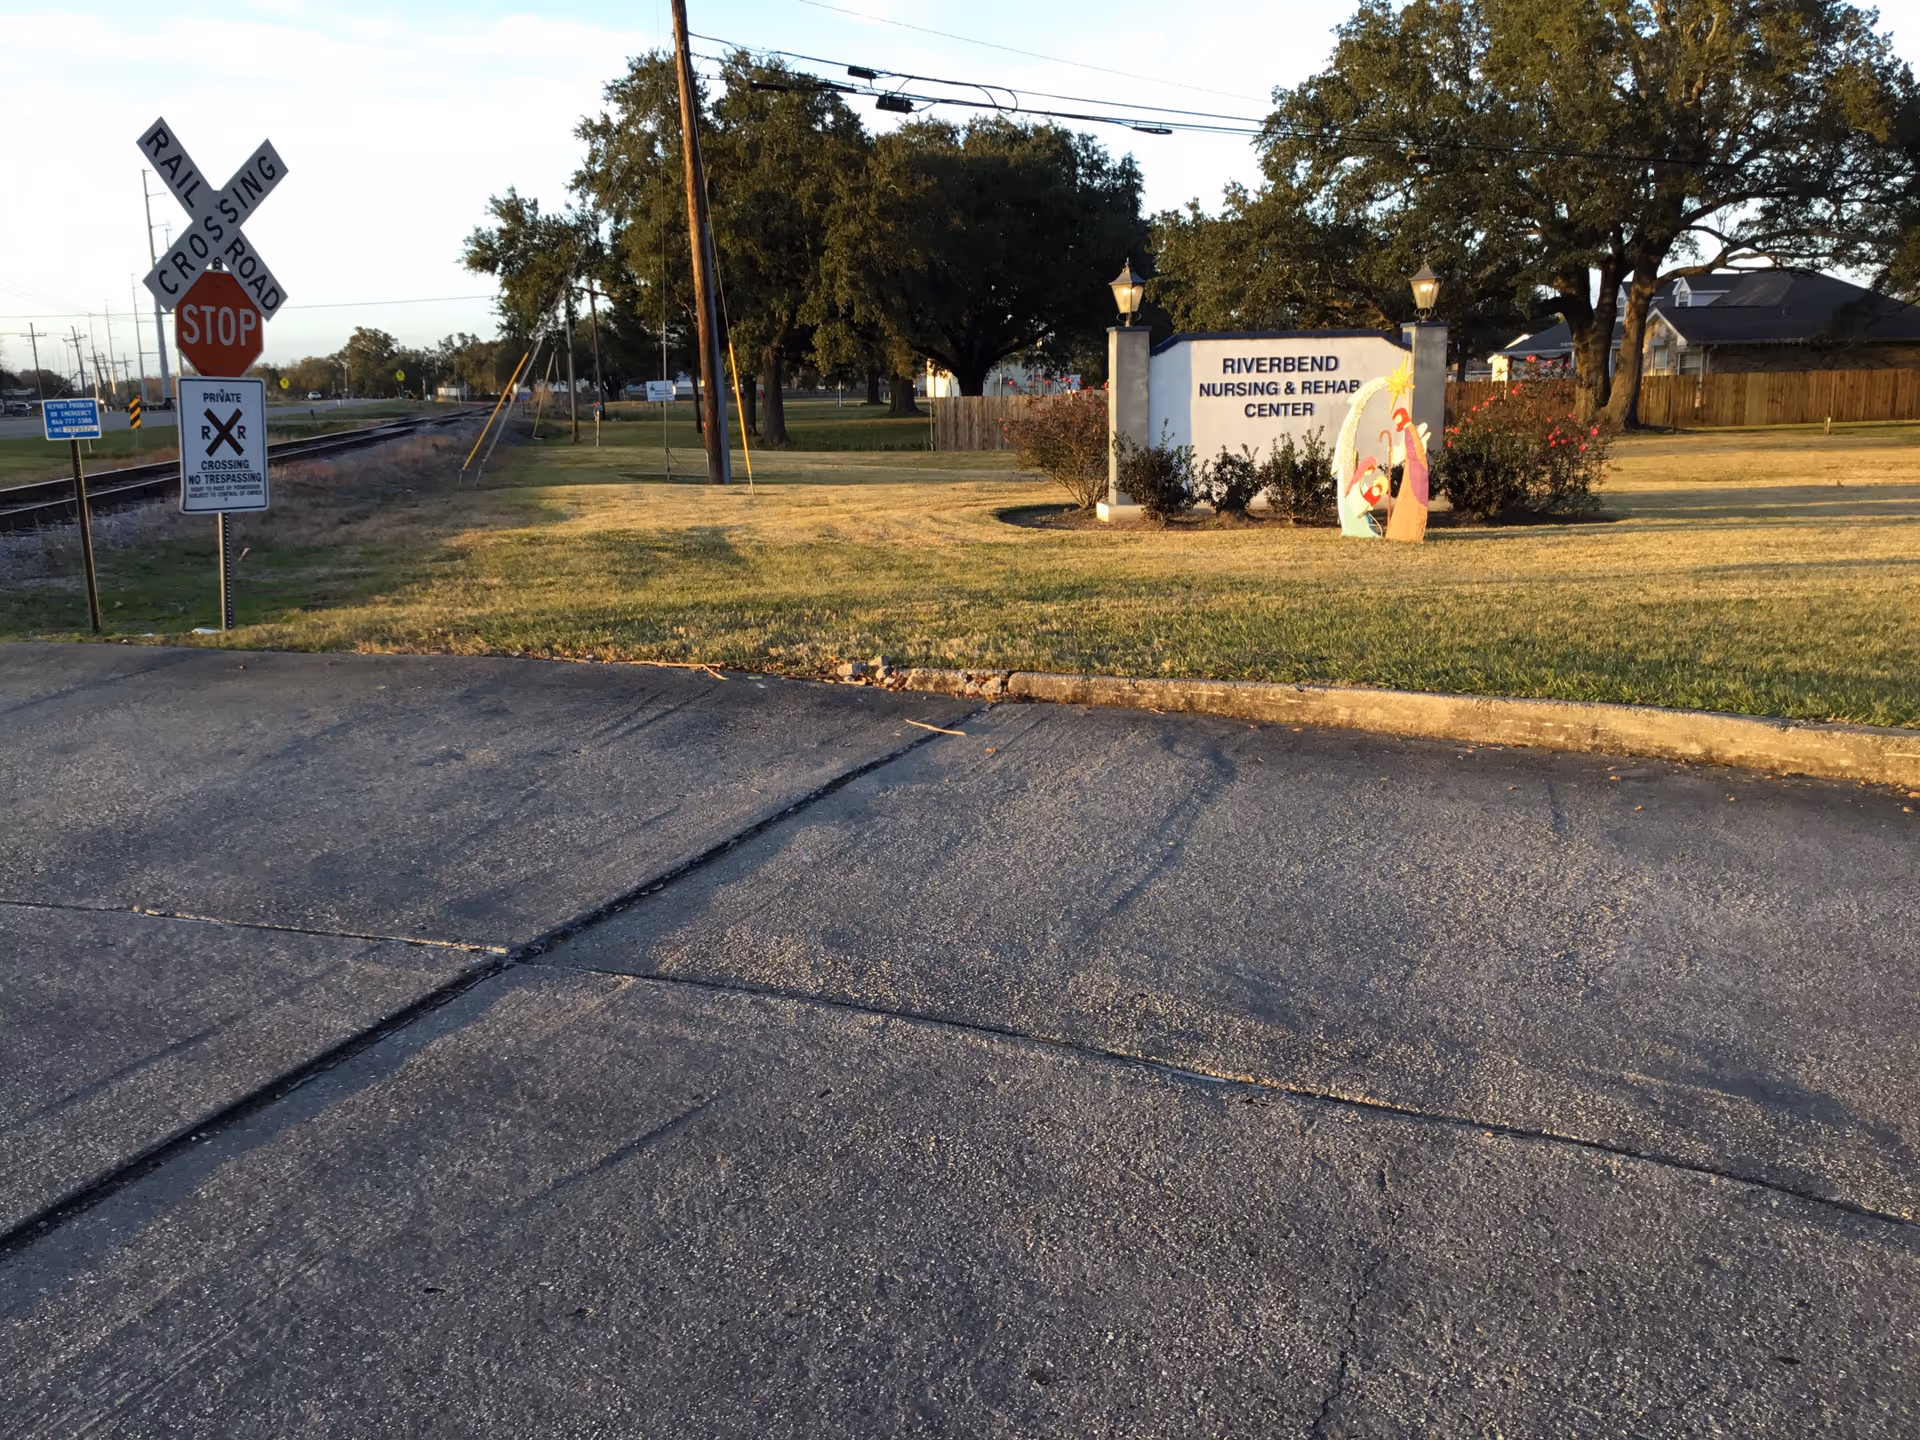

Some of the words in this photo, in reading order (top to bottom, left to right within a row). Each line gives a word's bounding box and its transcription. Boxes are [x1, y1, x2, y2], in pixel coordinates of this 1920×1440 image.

[145, 127, 201, 208] RAIL
[224, 236, 280, 312] ROAD
[158, 155, 276, 295] CROSSING
[182, 303, 257, 346] STOP
[1222, 355, 1340, 375] RIVERBEND
[202, 392, 242, 404] PRIVATE
[1199, 381, 1280, 398] NURSING
[1284, 380, 1296, 396] &
[1301, 379, 1361, 395] REHAB
[1244, 402, 1315, 418] CENTER
[201, 459, 250, 471] CROSSING
[188, 474, 201, 485] NO
[204, 472, 262, 485] TRESPASSING
